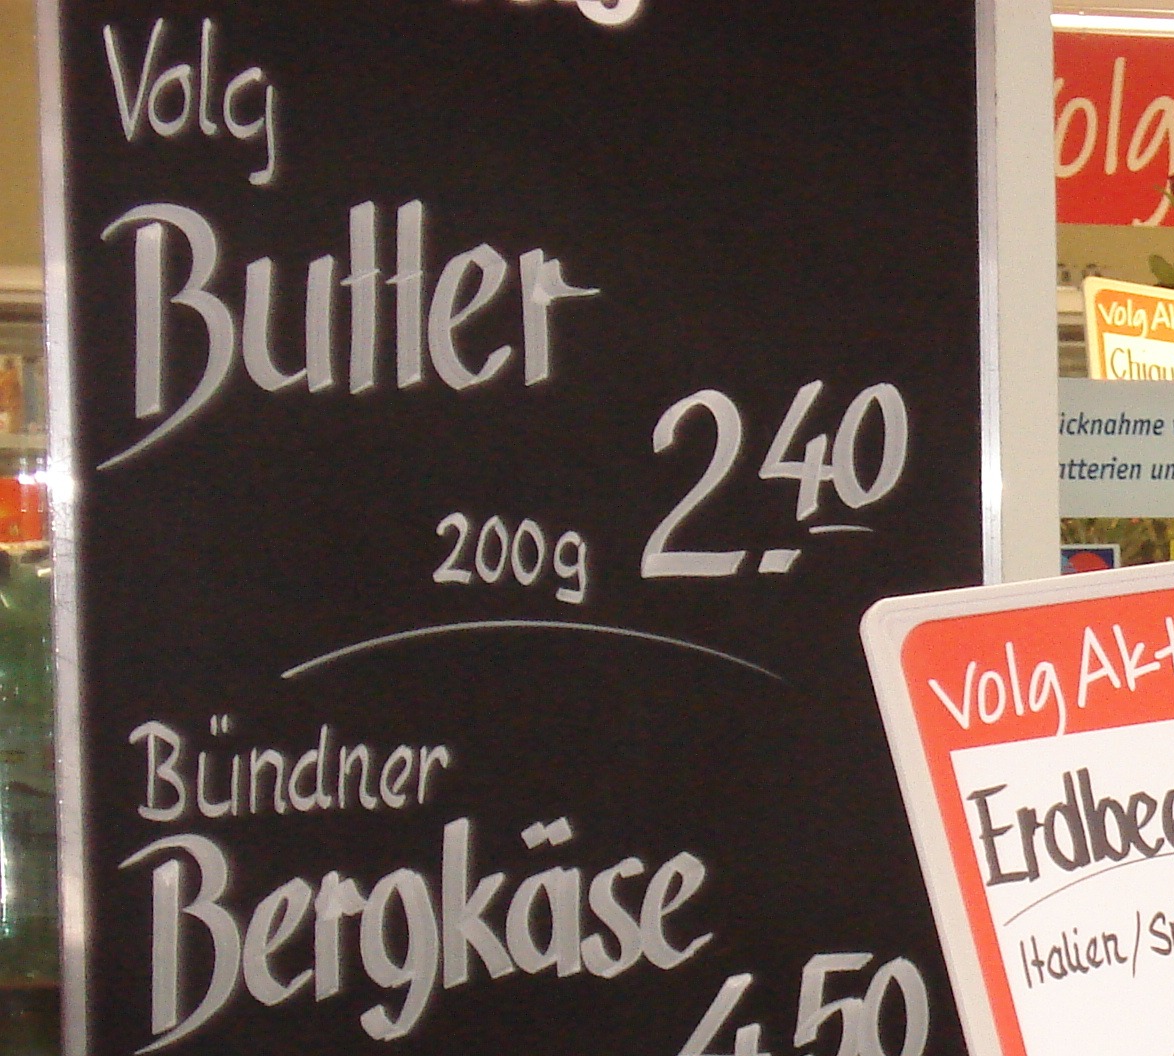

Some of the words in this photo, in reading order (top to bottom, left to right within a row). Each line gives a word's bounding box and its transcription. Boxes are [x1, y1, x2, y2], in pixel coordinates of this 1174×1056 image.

[102, 17, 276, 186] Volg
[97, 199, 601, 471] Butter
[1097, 298, 1149, 338] Volg
[640, 377, 909, 580] 2.40
[432, 511, 590, 604] 200g
[928, 641, 1069, 736] Volg
[128, 713, 452, 823] Bündner
[117, 816, 713, 1056] Bergkäse
